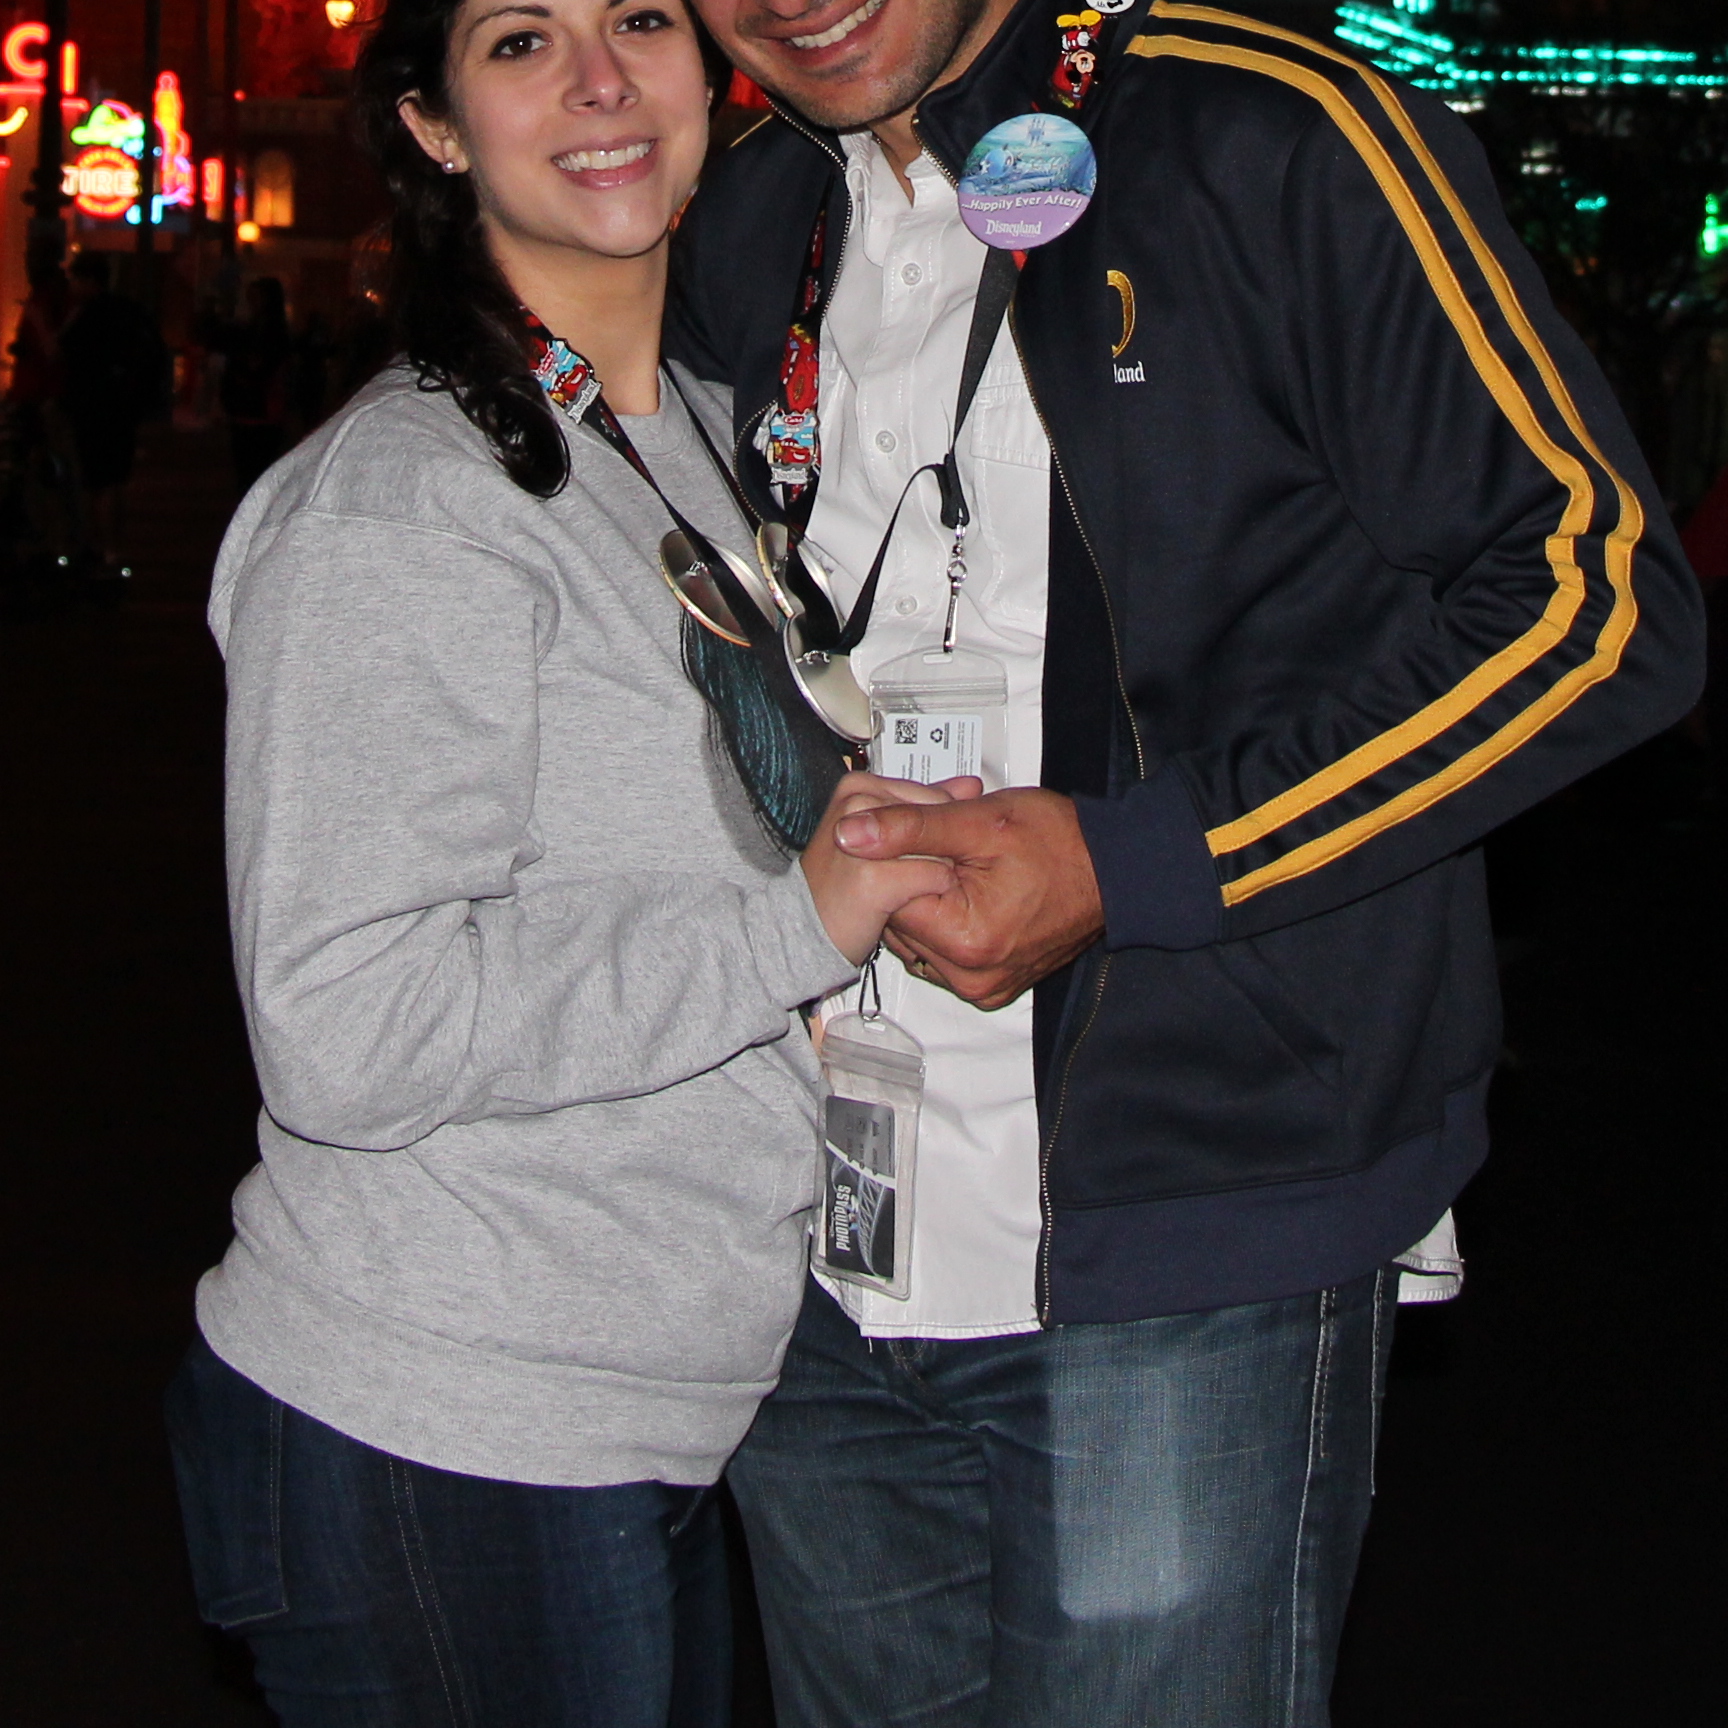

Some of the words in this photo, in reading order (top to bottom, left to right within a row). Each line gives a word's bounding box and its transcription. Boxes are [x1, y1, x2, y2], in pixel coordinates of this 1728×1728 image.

[1015, 196, 1041, 207] Ever
[1044, 193, 1083, 209] After!
[985, 218, 1042, 237] Disneyland
[835, 1183, 852, 1253] PHOTOPASS
